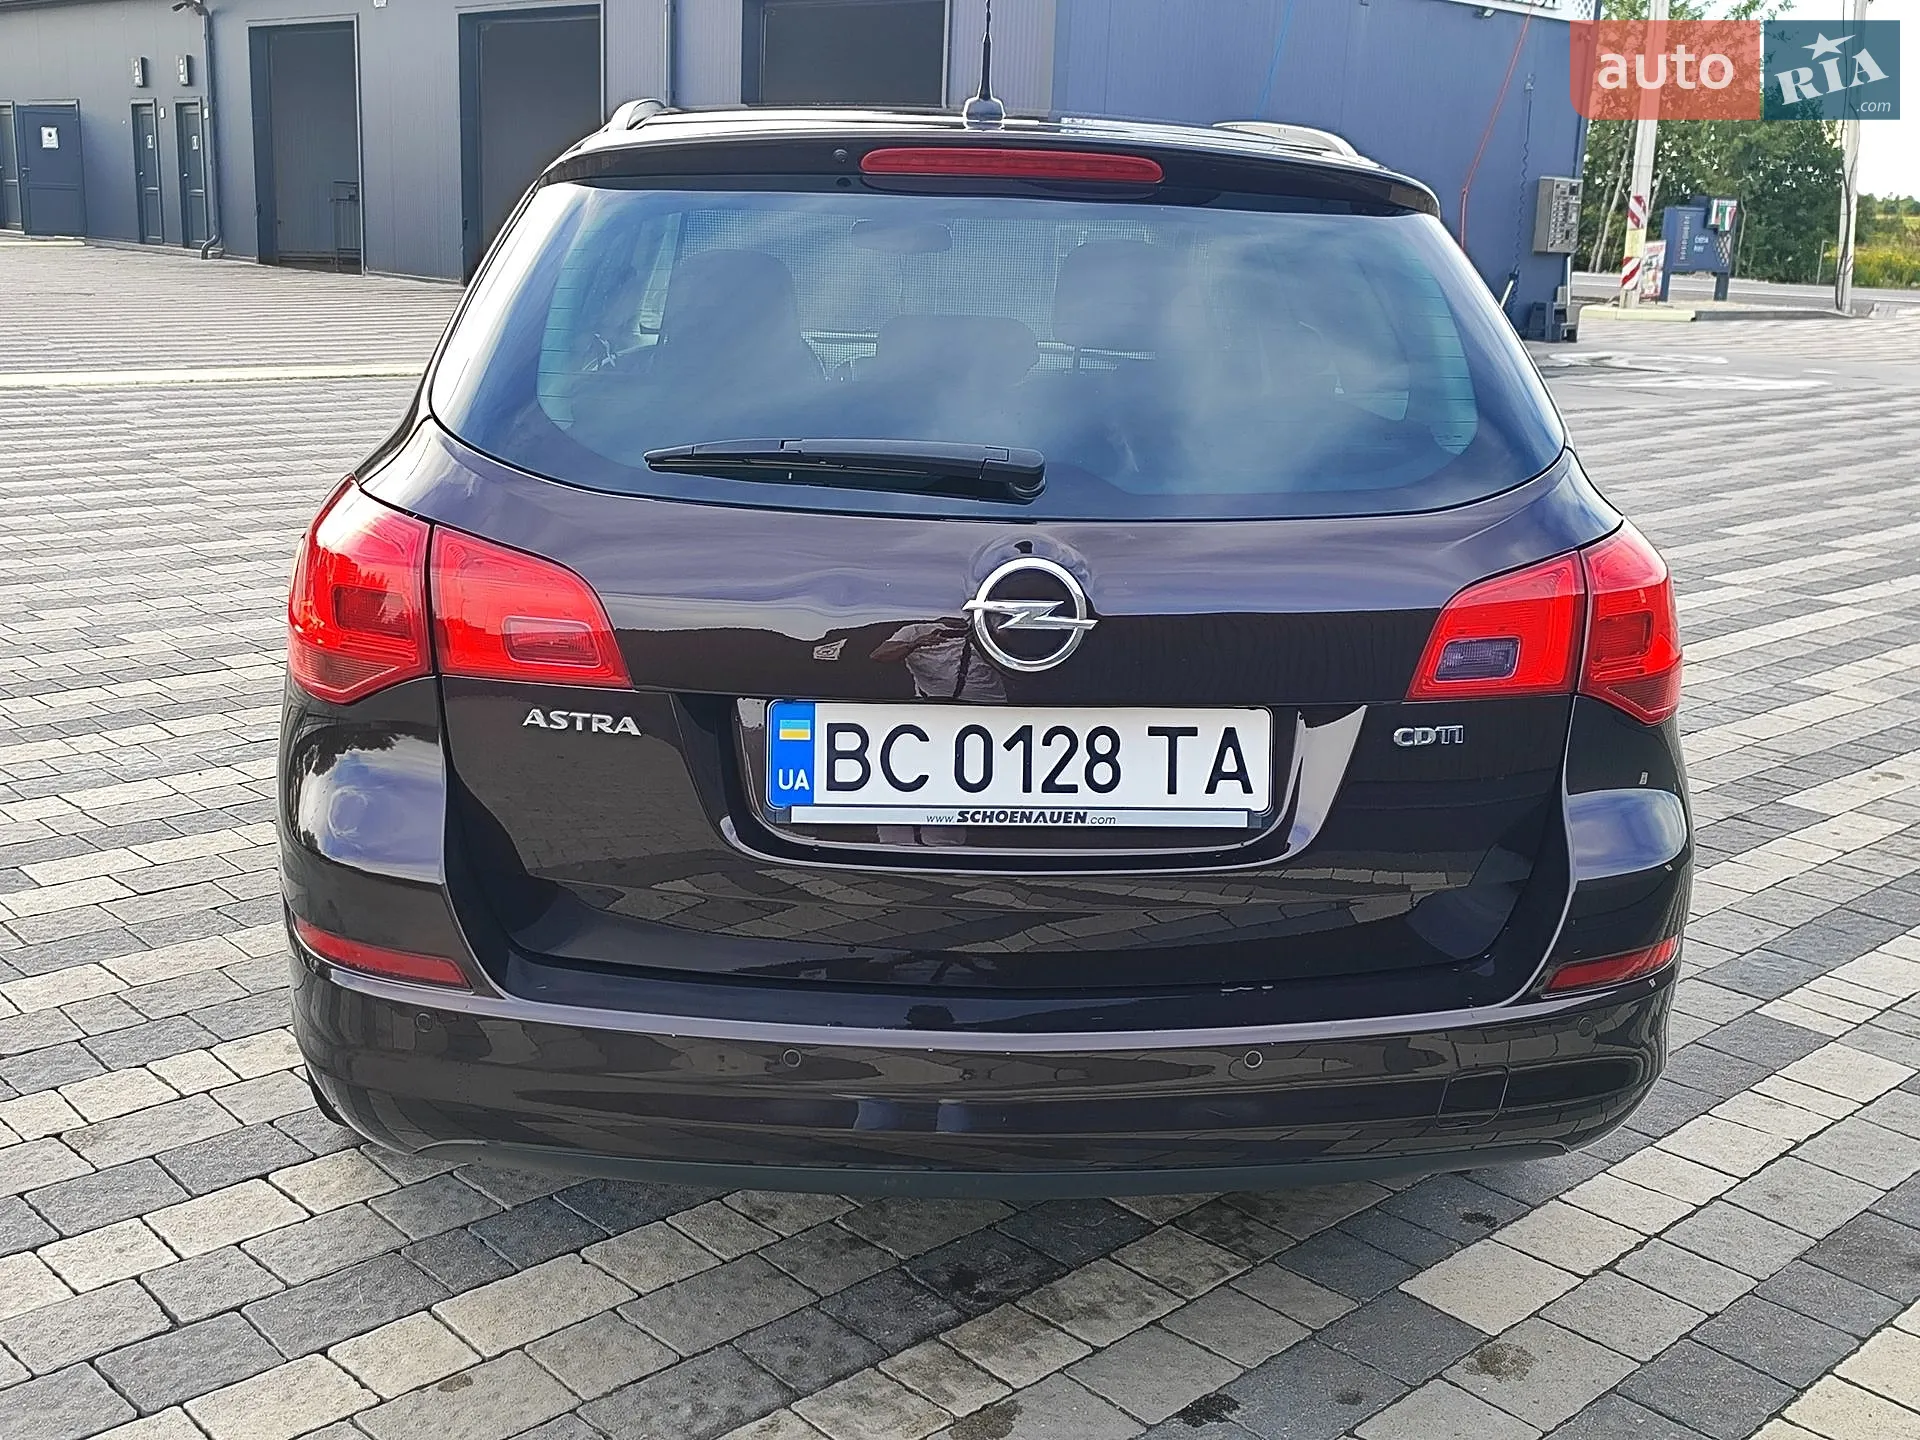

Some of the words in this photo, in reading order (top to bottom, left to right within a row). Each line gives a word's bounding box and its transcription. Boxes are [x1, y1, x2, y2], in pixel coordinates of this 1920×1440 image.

[522, 708, 641, 736] ASTRA
[1393, 724, 1464, 747] CDTI
[826, 722, 930, 793] BC
[954, 723, 1122, 794] 0128
[1148, 725, 1254, 796] TA
[779, 768, 811, 791] UA
